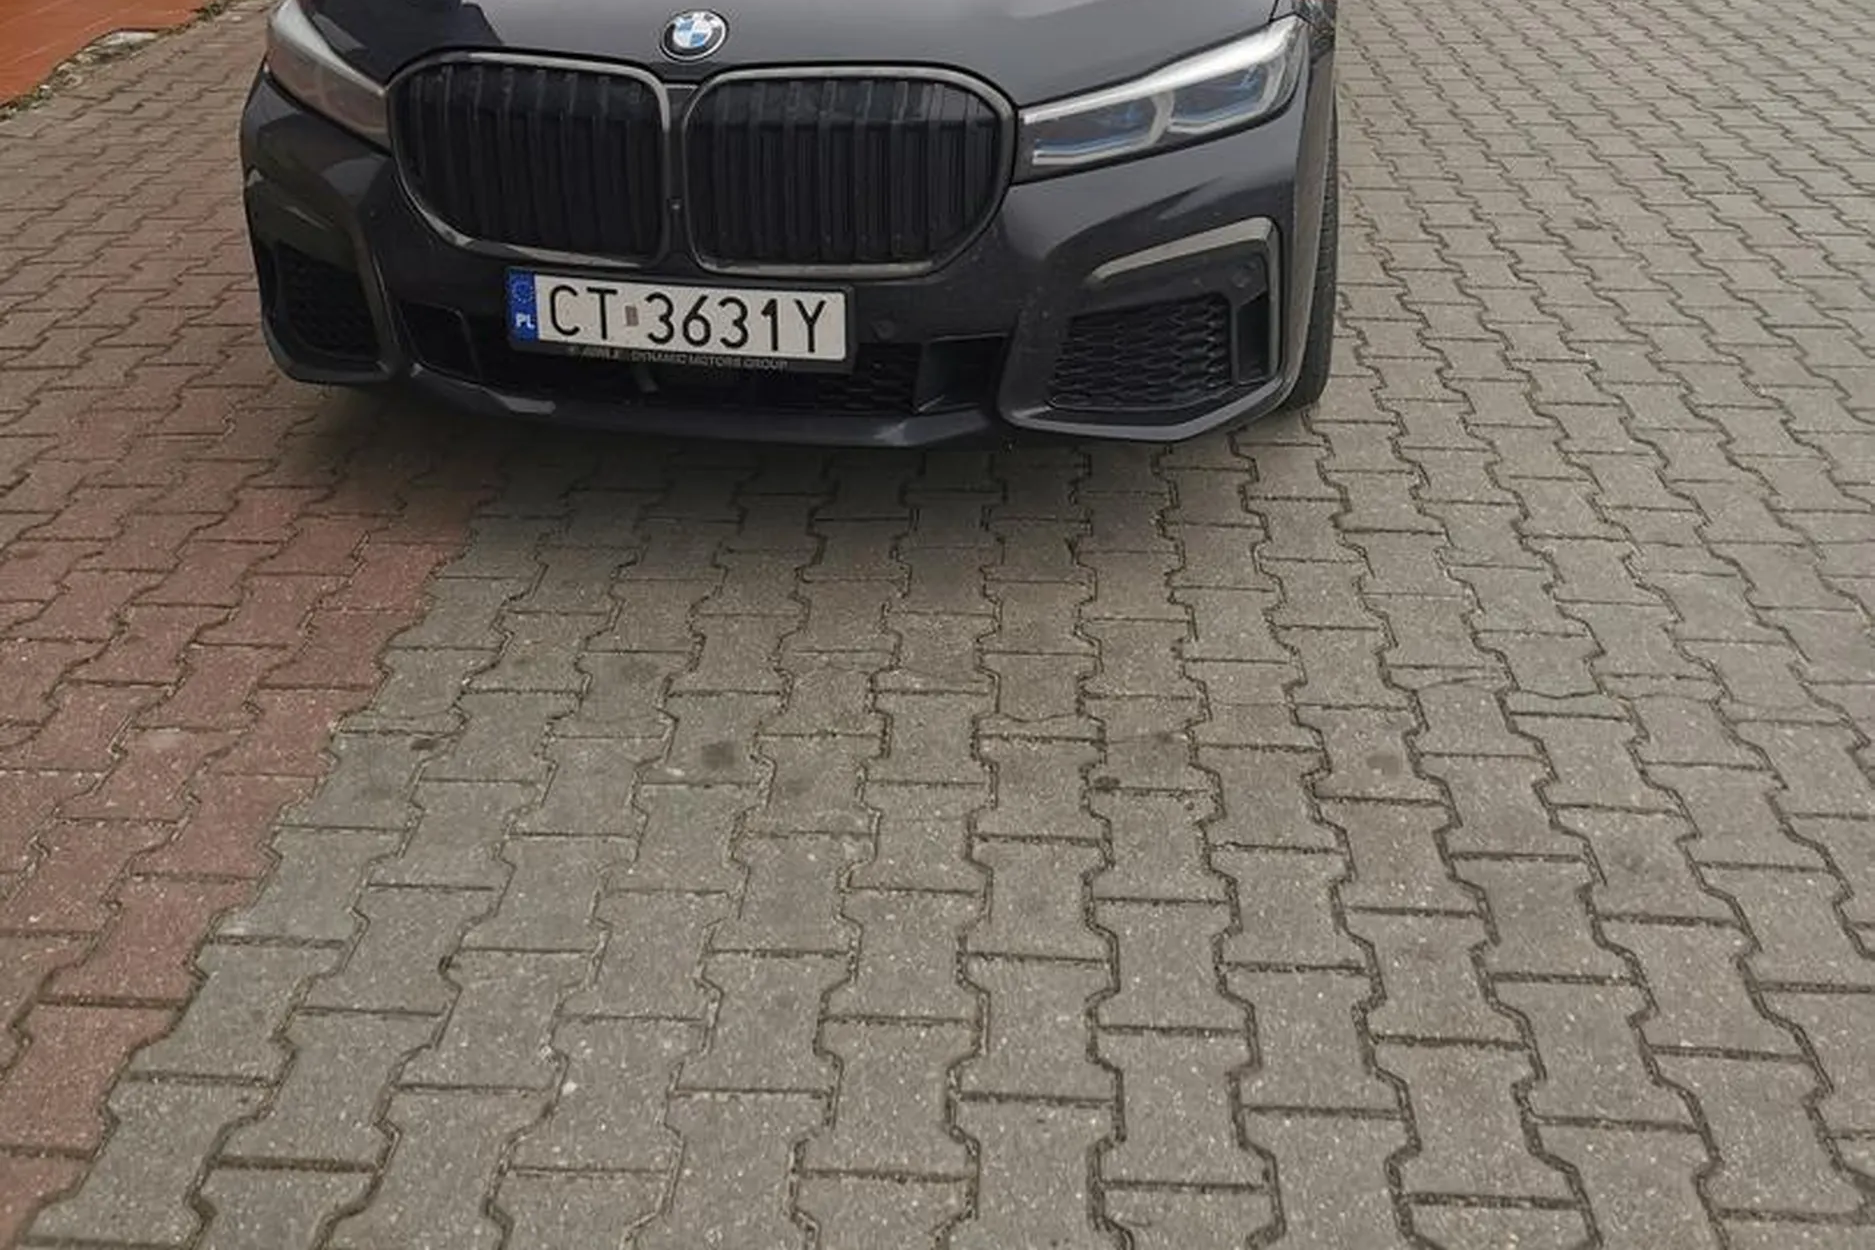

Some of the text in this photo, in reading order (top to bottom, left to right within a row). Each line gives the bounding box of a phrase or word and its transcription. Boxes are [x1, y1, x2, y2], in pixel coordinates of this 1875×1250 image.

[516, 313, 535, 329] PL
[550, 285, 826, 353] CT 3631Y
[689, 354, 742, 369] MOTORS
